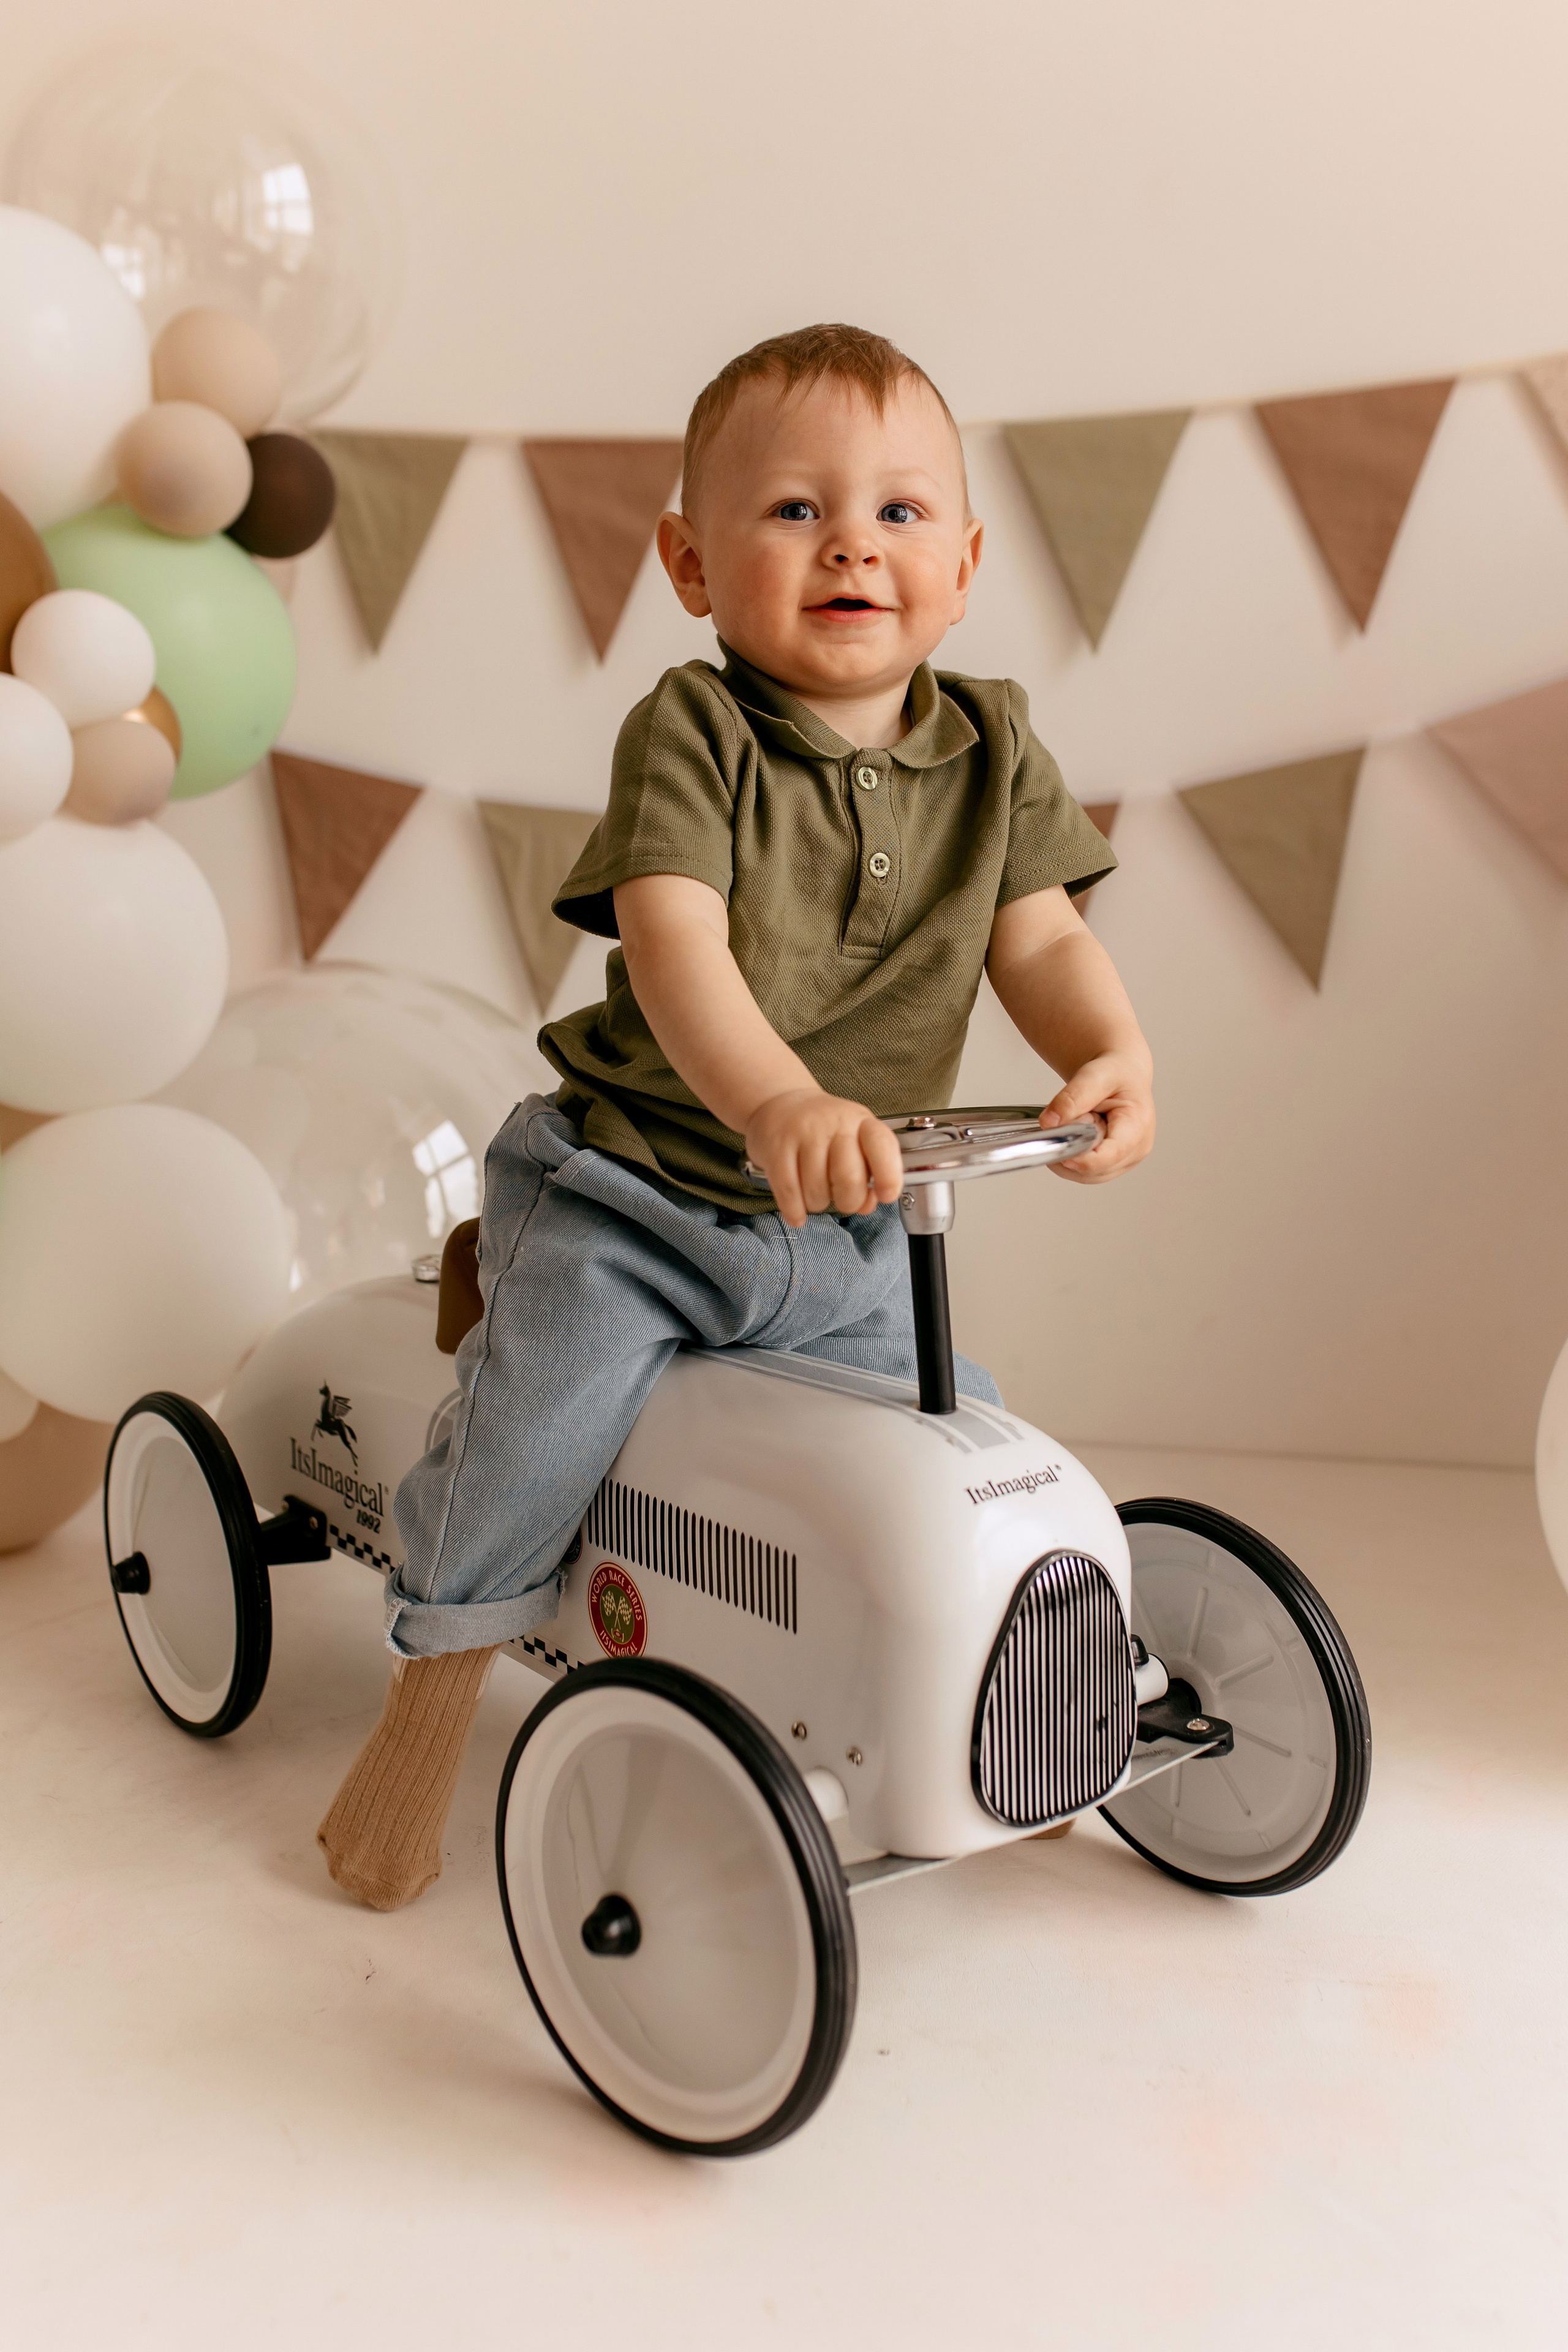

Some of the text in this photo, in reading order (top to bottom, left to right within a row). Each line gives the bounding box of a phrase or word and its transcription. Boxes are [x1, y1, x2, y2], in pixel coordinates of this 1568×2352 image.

[356, 1509, 381, 1534] 1992
[592, 1570, 643, 1621] WORLD RACE SERIES
[600, 1629, 638, 1657] ITSIMAGICAL
